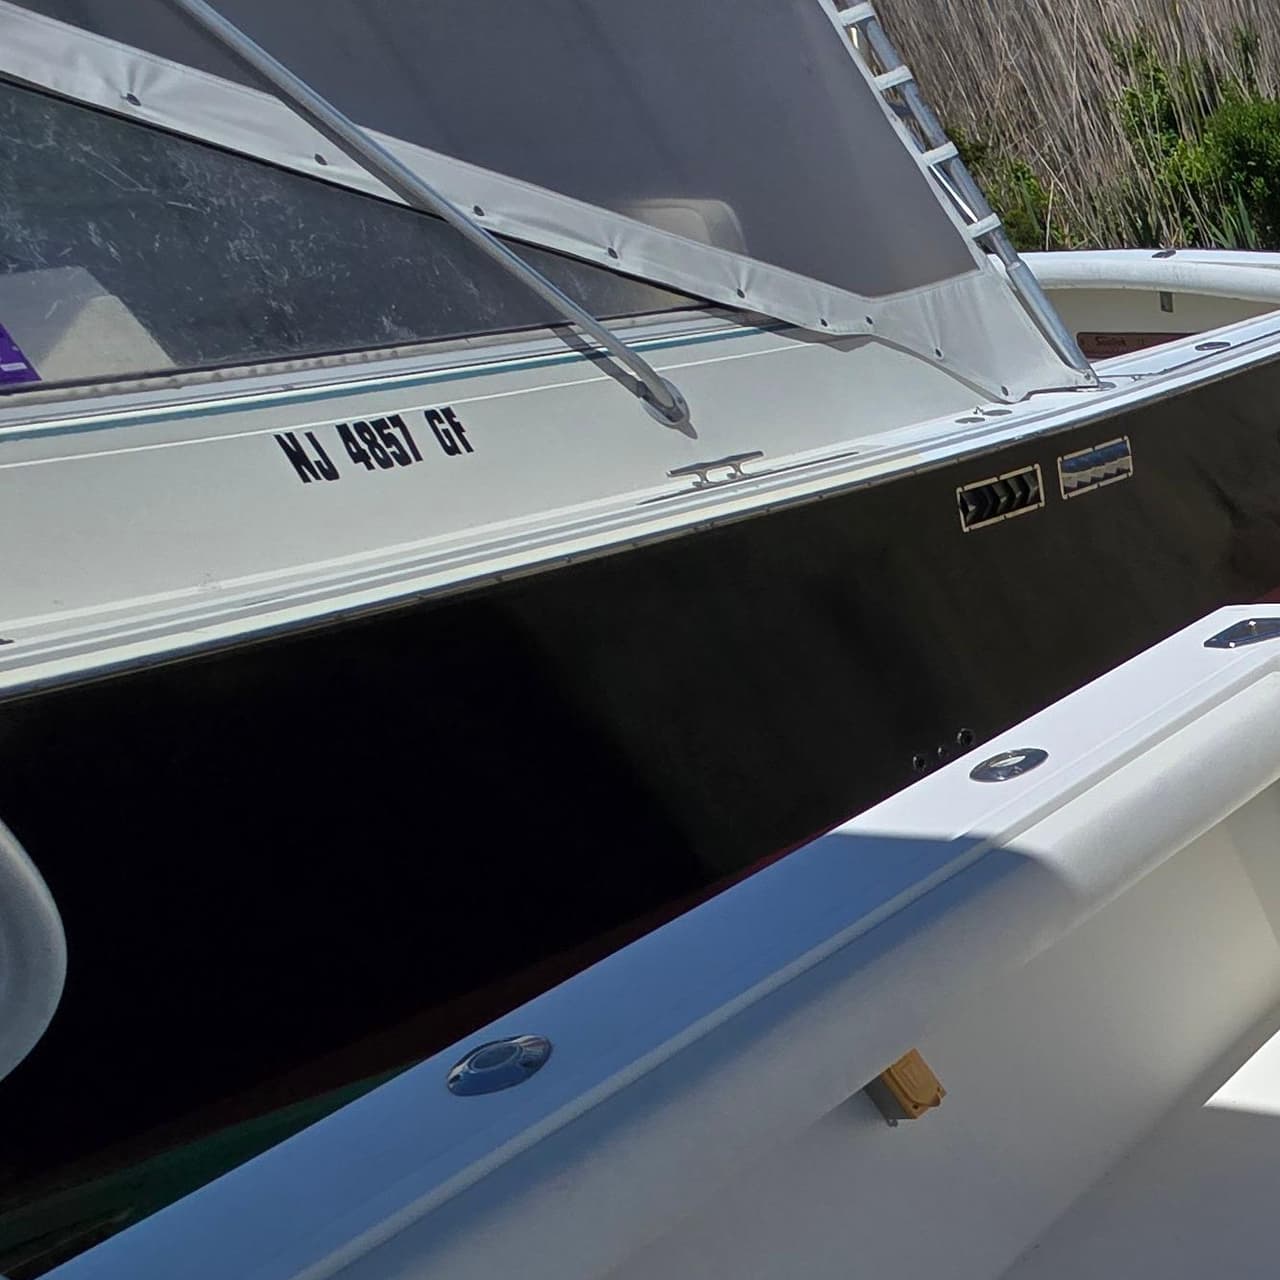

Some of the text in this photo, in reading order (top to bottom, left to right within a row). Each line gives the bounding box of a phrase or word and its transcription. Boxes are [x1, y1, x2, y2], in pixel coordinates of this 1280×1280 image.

[273, 407, 474, 483] NJ 4857 GF
